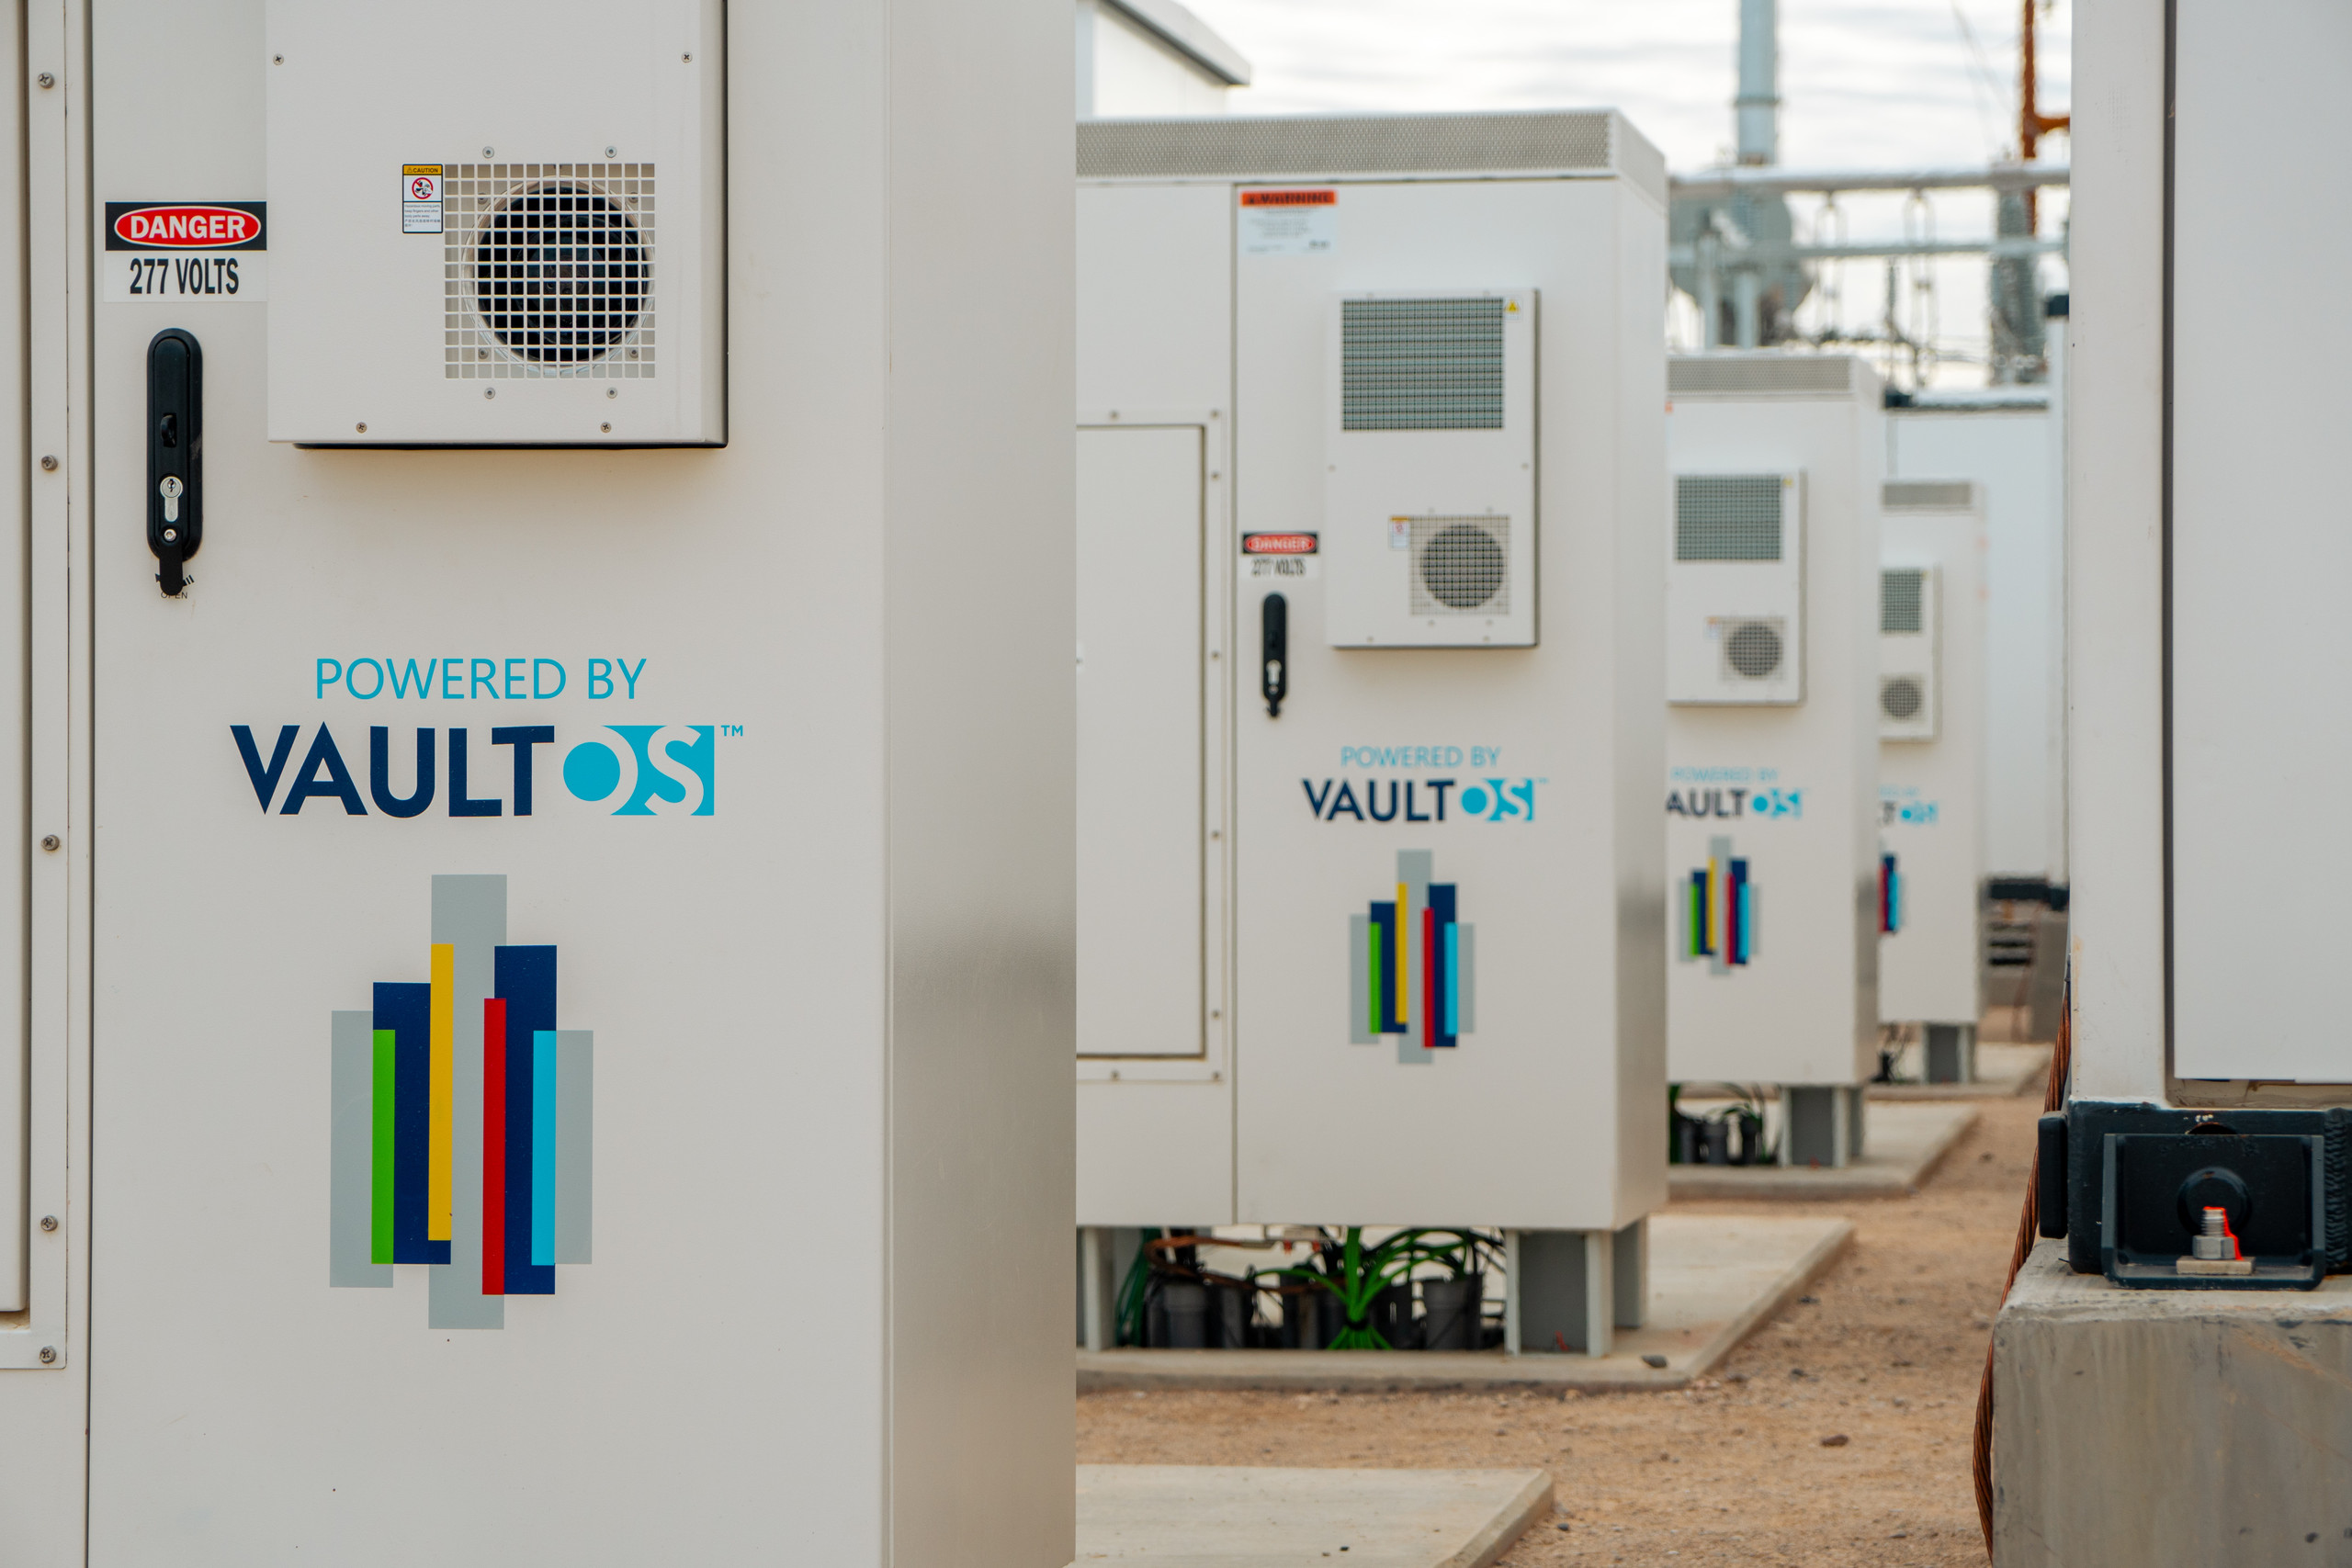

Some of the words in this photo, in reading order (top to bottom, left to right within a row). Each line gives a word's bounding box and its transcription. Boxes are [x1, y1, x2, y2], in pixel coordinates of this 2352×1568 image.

[130, 215, 245, 239] DANGER
[130, 257, 169, 294] 277
[175, 257, 239, 294] VOLTS
[161, 591, 188, 599] OEN
[316, 658, 567, 699] POWERED
[588, 658, 647, 699] BY
[1340, 746, 1464, 768] POWERED
[1471, 746, 1502, 768] BY
